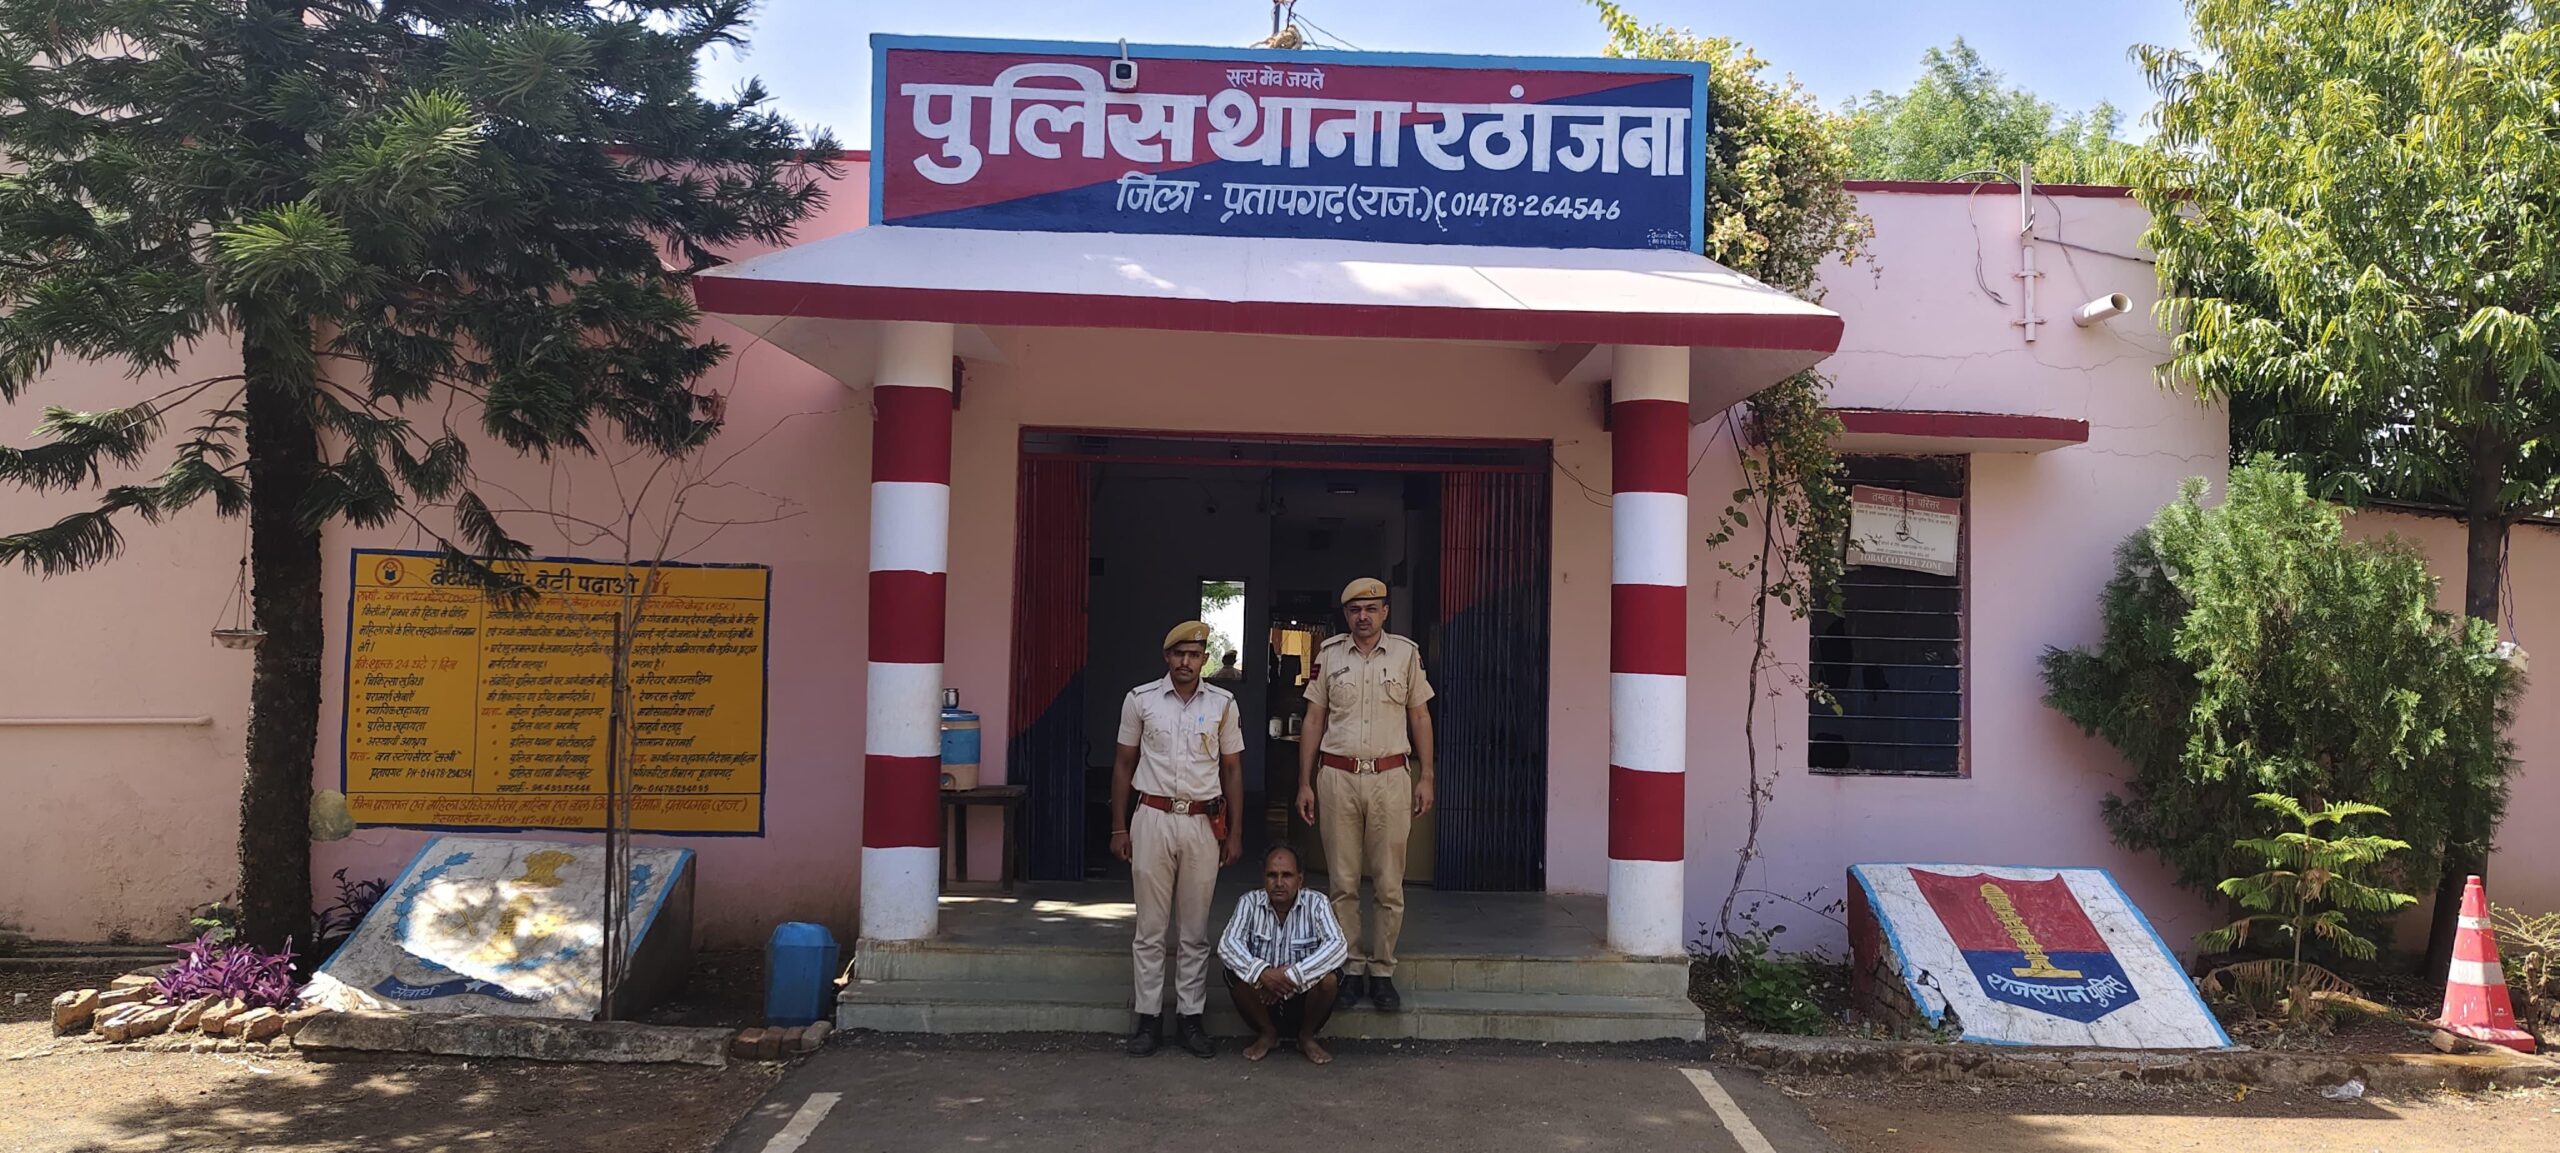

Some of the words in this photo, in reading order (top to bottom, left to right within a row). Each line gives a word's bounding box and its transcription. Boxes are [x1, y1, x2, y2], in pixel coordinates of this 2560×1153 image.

[1226, 69, 1258, 88] सत्य
[1259, 65, 1284, 87] मेव
[1285, 68, 1325, 90] जयते
[901, 62, 1206, 184] पुलिस
[1207, 88, 1413, 168] थाना
[1415, 84, 1692, 177] रठांजना
[1116, 171, 1200, 214] जिला
[1450, 191, 1622, 222] 01478-264546
[1860, 553, 1898, 565] TOBACCO
[1921, 560, 1944, 571] ZONE
[536, 568, 575, 589] बेटी
[367, 716, 393, 733] पुलिस
[393, 721, 428, 734] सहायता
[1987, 973, 2091, 1005] राजस्थान
[2086, 974, 2128, 1008] पुलिस
